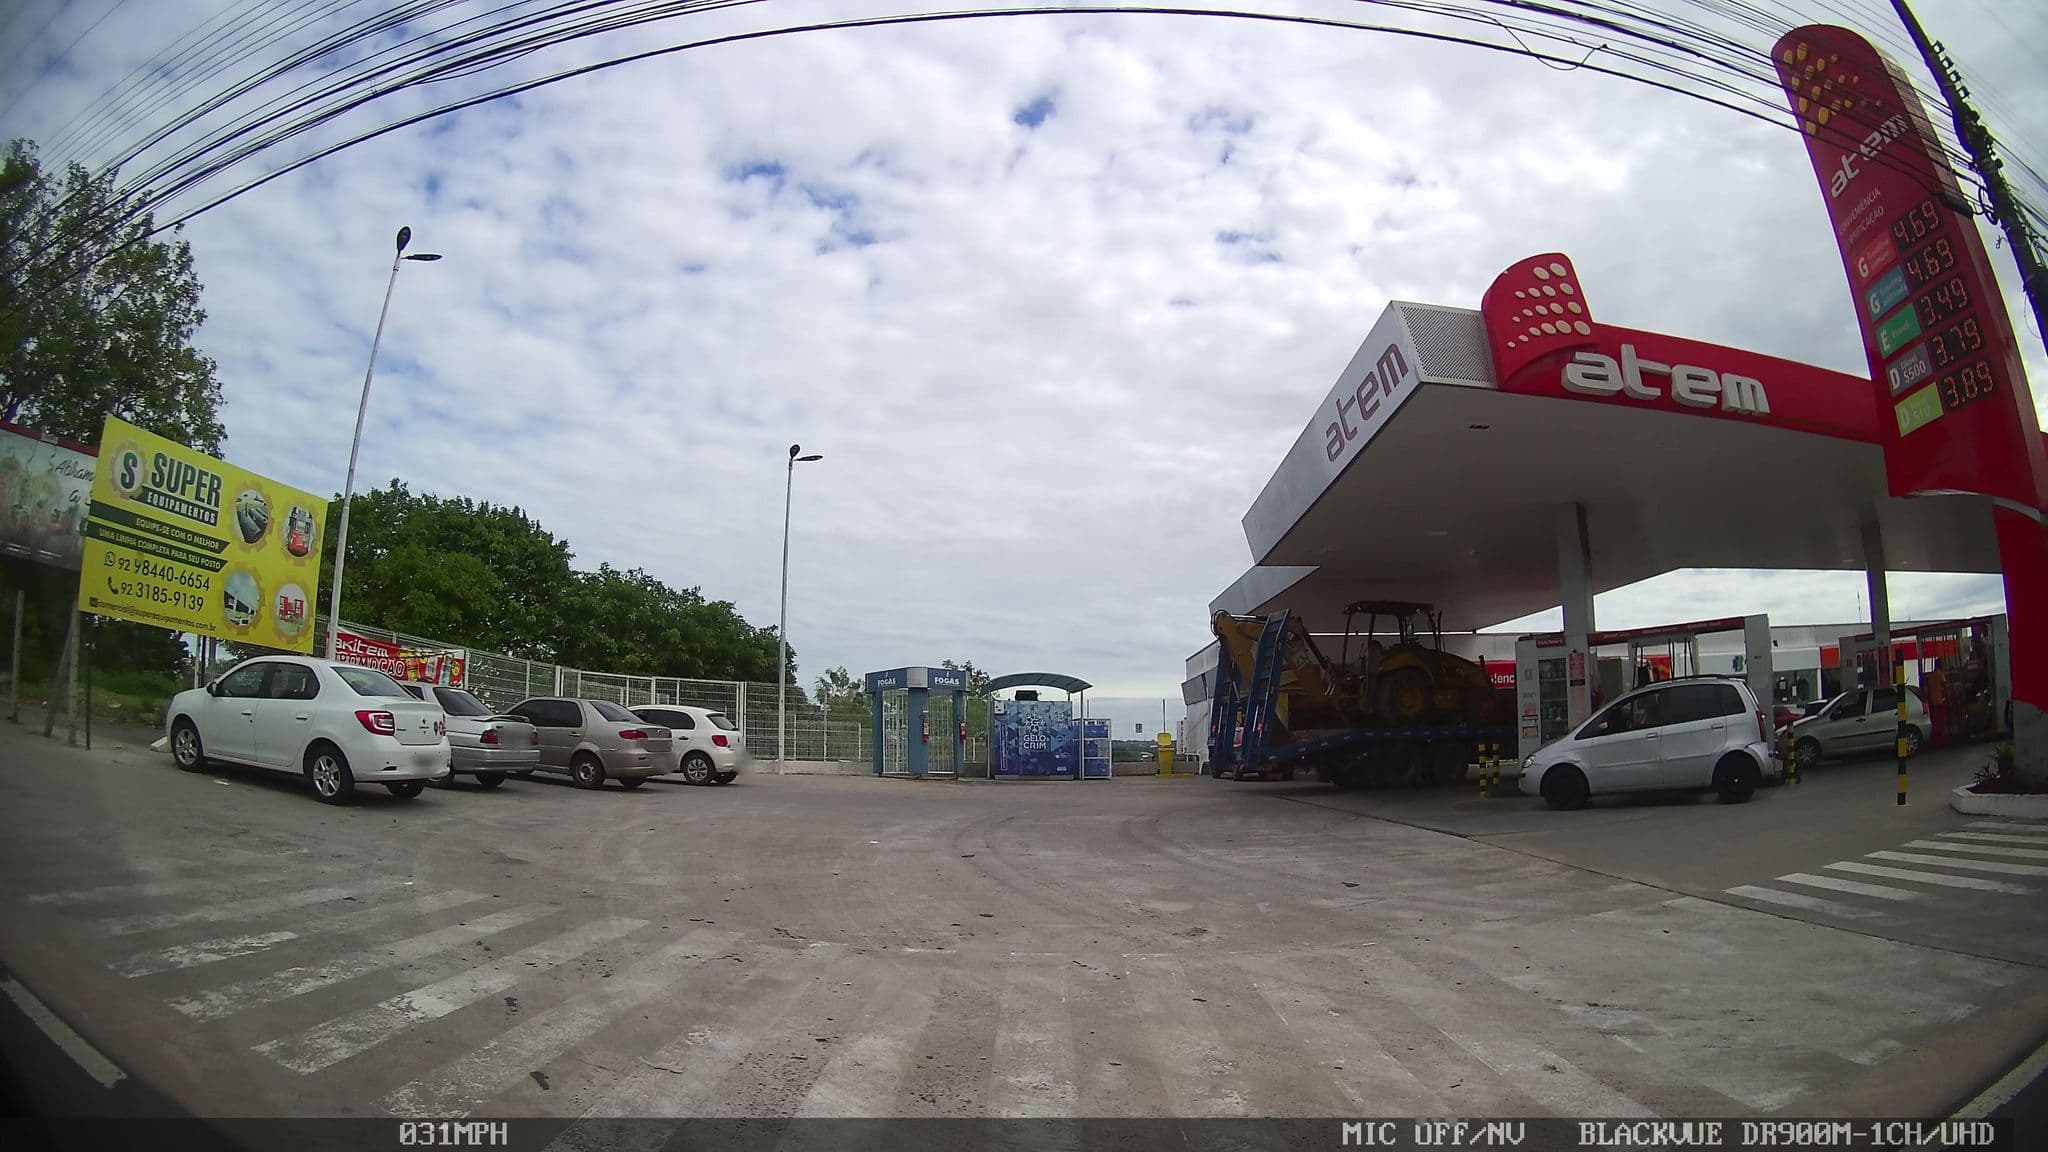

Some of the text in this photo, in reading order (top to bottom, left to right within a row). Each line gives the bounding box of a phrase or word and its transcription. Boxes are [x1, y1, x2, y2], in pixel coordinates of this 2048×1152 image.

[1831, 114, 1909, 198] atem
[1858, 200, 1939, 278] G 4.69
[1870, 292, 1881, 314] G
[1907, 238, 1954, 281] 4.69
[1881, 329, 1891, 352] E
[1920, 277, 1968, 326] 3.49
[1561, 344, 1770, 416] atem
[1889, 367, 1900, 391] D
[1932, 317, 1981, 367] 3.79
[1326, 343, 1409, 463] atem
[1944, 360, 1994, 408] 3.89
[151, 452, 222, 508] SUPER
[147, 491, 216, 524] EQUIPAMENTOS
[99, 528, 220, 569] UMA LINHA COMPLETA PARA SEU POSTO
[135, 518, 219, 550] EQUIPE-SE COM O MELHOR
[118, 557, 210, 592] 92 98440-6654
[120, 581, 204, 612] 92 3185-9139
[1023, 733, 1047, 742] GELO
[1023, 741, 1046, 749] CRIM
